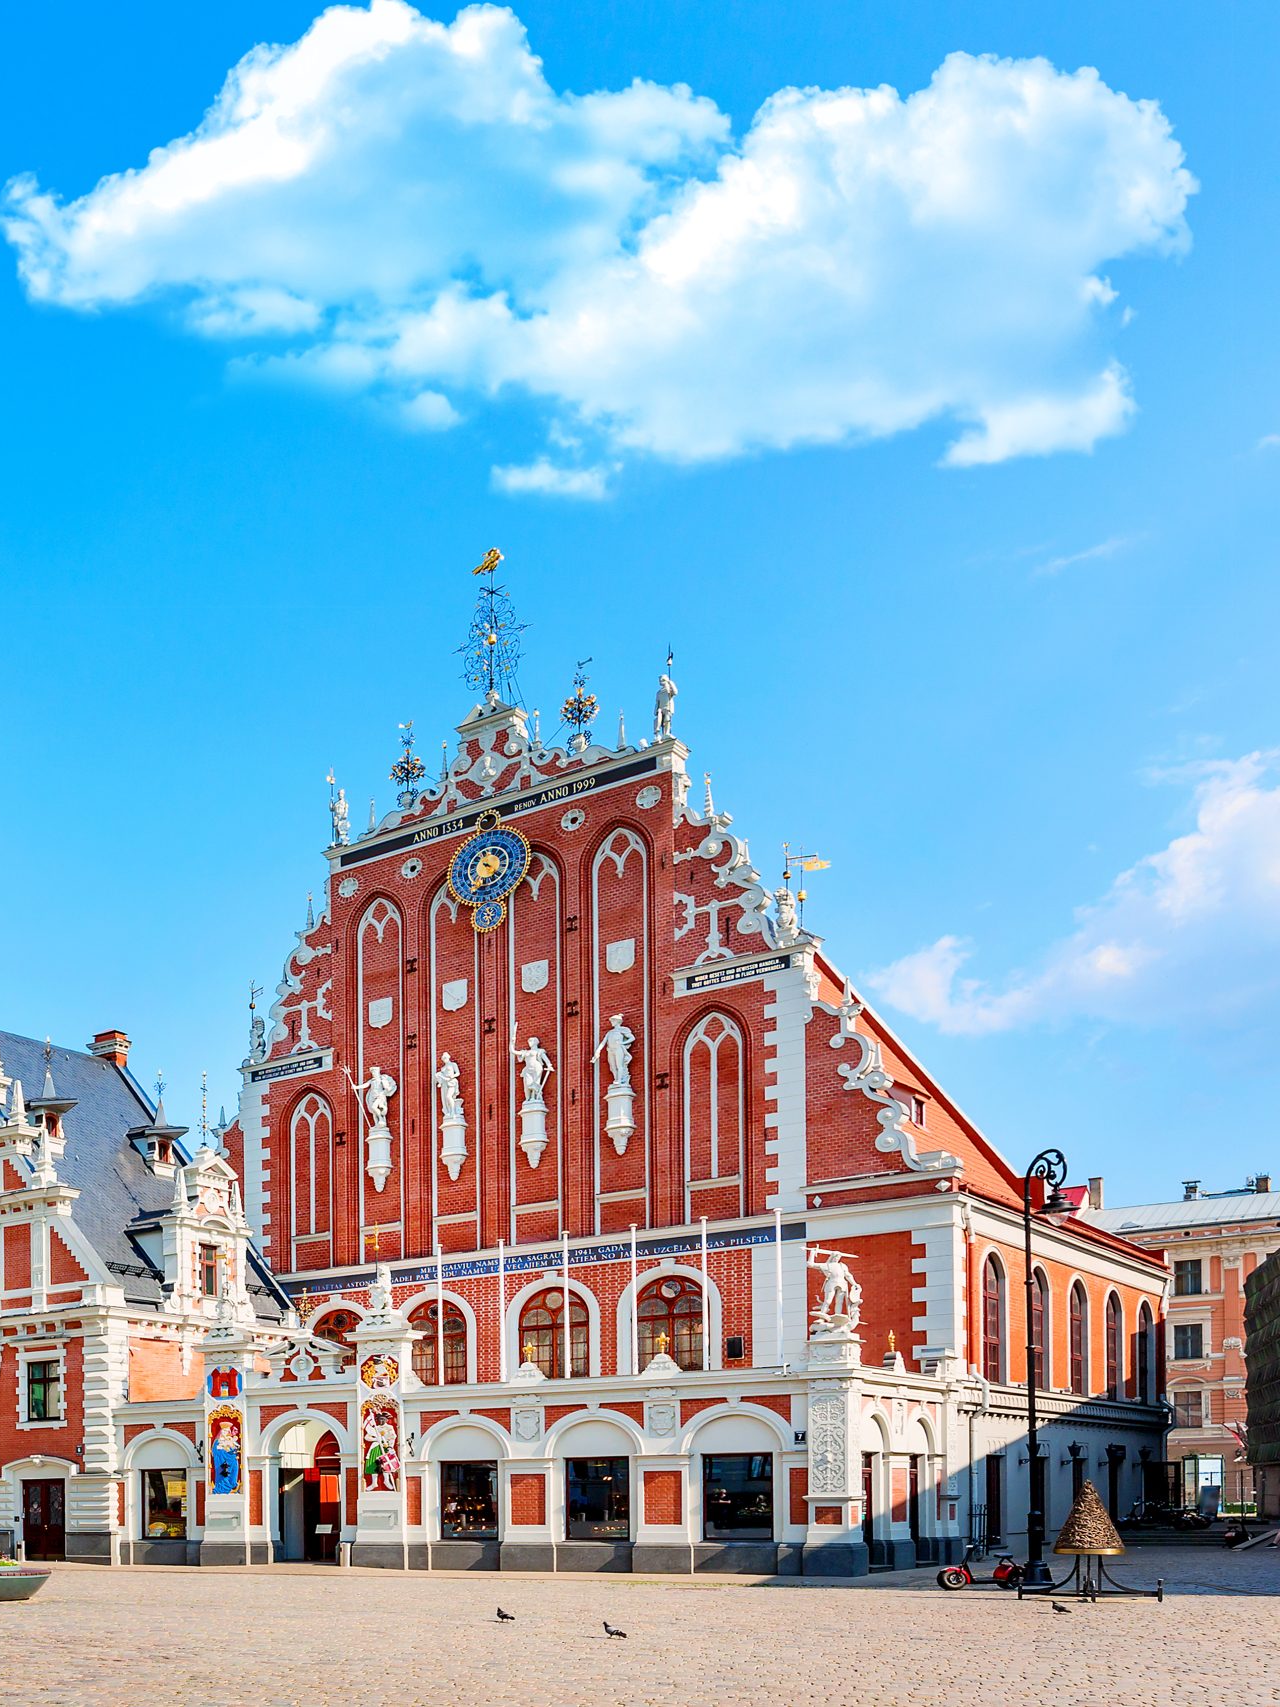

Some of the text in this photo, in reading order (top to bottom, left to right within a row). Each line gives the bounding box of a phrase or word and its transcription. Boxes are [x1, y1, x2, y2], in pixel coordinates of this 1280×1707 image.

[413, 827, 439, 843] ANNO
[442, 819, 464, 833] 1334
[540, 786, 569, 804] ANNO
[572, 777, 596, 794] 1999
[420, 1261, 471, 1274] MELGALVJU
[475, 1259, 498, 1267] NAMS
[503, 1256, 522, 1264] TIKA
[461, 1267, 486, 1275] NAMU
[506, 1259, 548, 1270] VECAJIEM
[552, 1254, 596, 1265] PAATIEM
[601, 1252, 615, 1260] NO
[620, 1249, 648, 1258] JANA
[695, 1239, 724, 1249] RGAS
